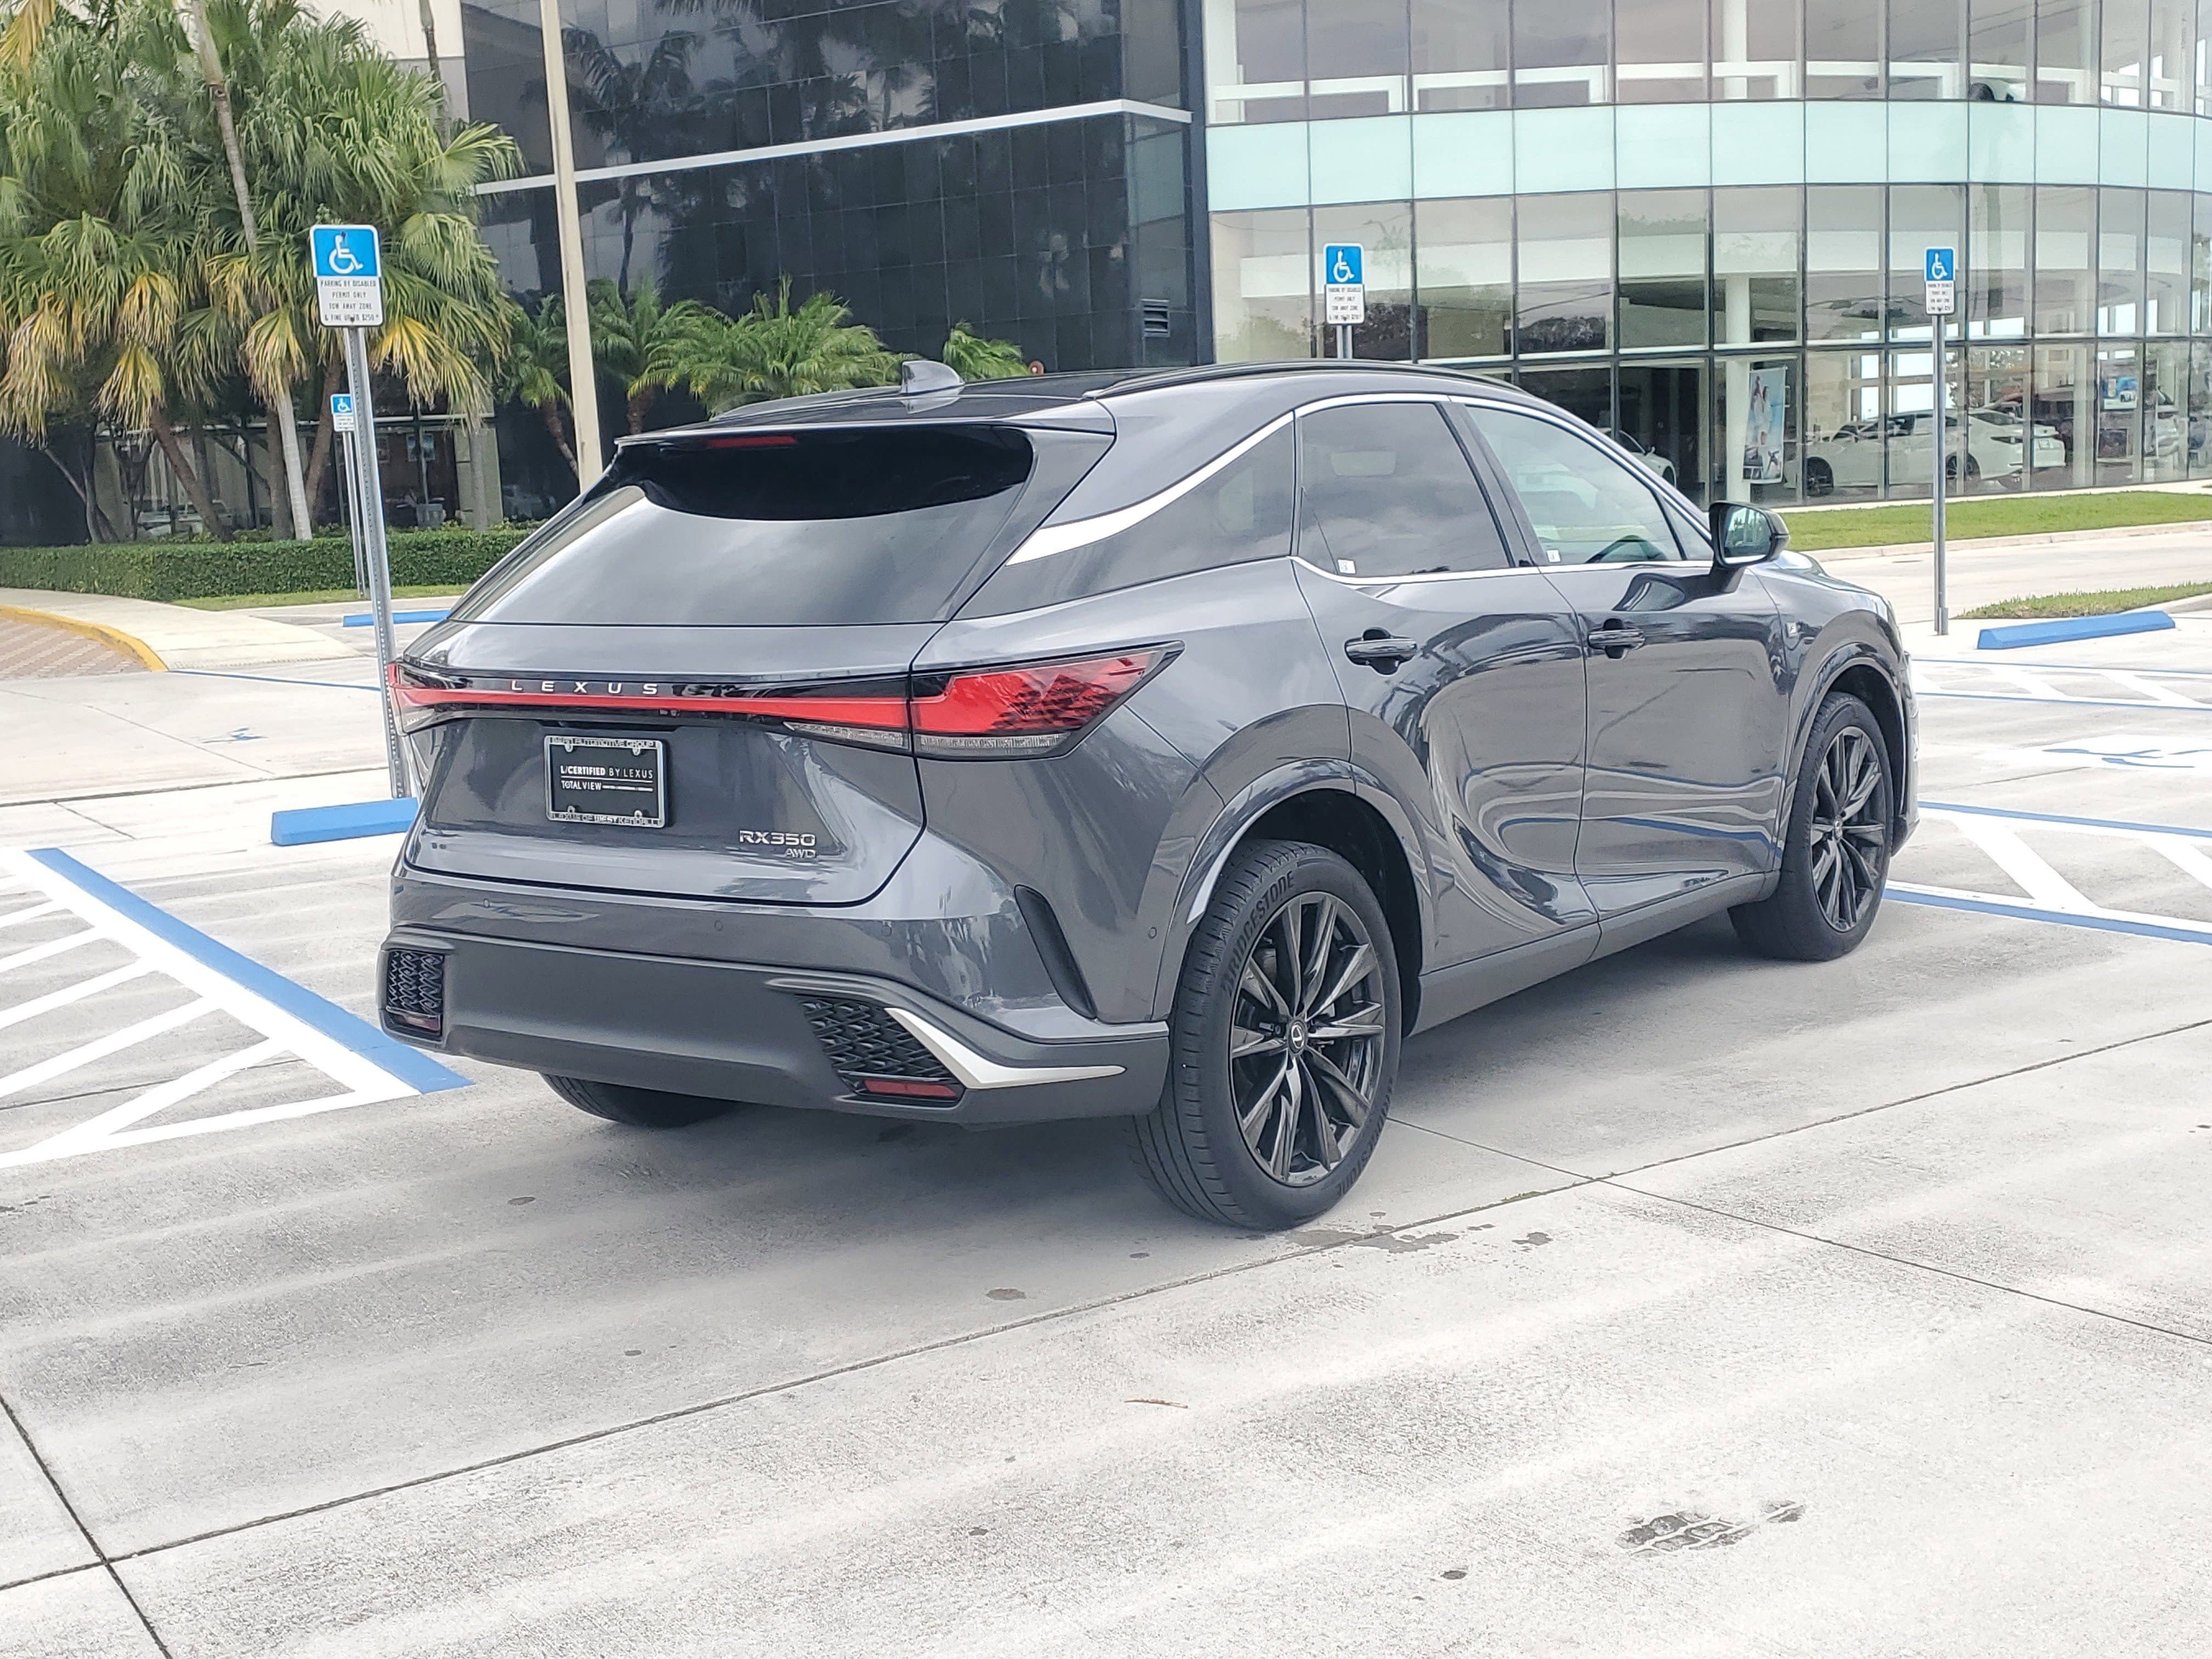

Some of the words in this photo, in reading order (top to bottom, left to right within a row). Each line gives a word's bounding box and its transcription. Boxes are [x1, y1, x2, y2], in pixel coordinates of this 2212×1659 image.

[511, 679, 658, 695] LEXUS
[609, 767, 620, 777] BY
[623, 768, 653, 779] LEXUS
[561, 780, 582, 790] TOTAL
[582, 781, 602, 791] VIEW
[785, 848, 816, 859] AWD
[1220, 870, 1295, 999] BRIDGESTONE
